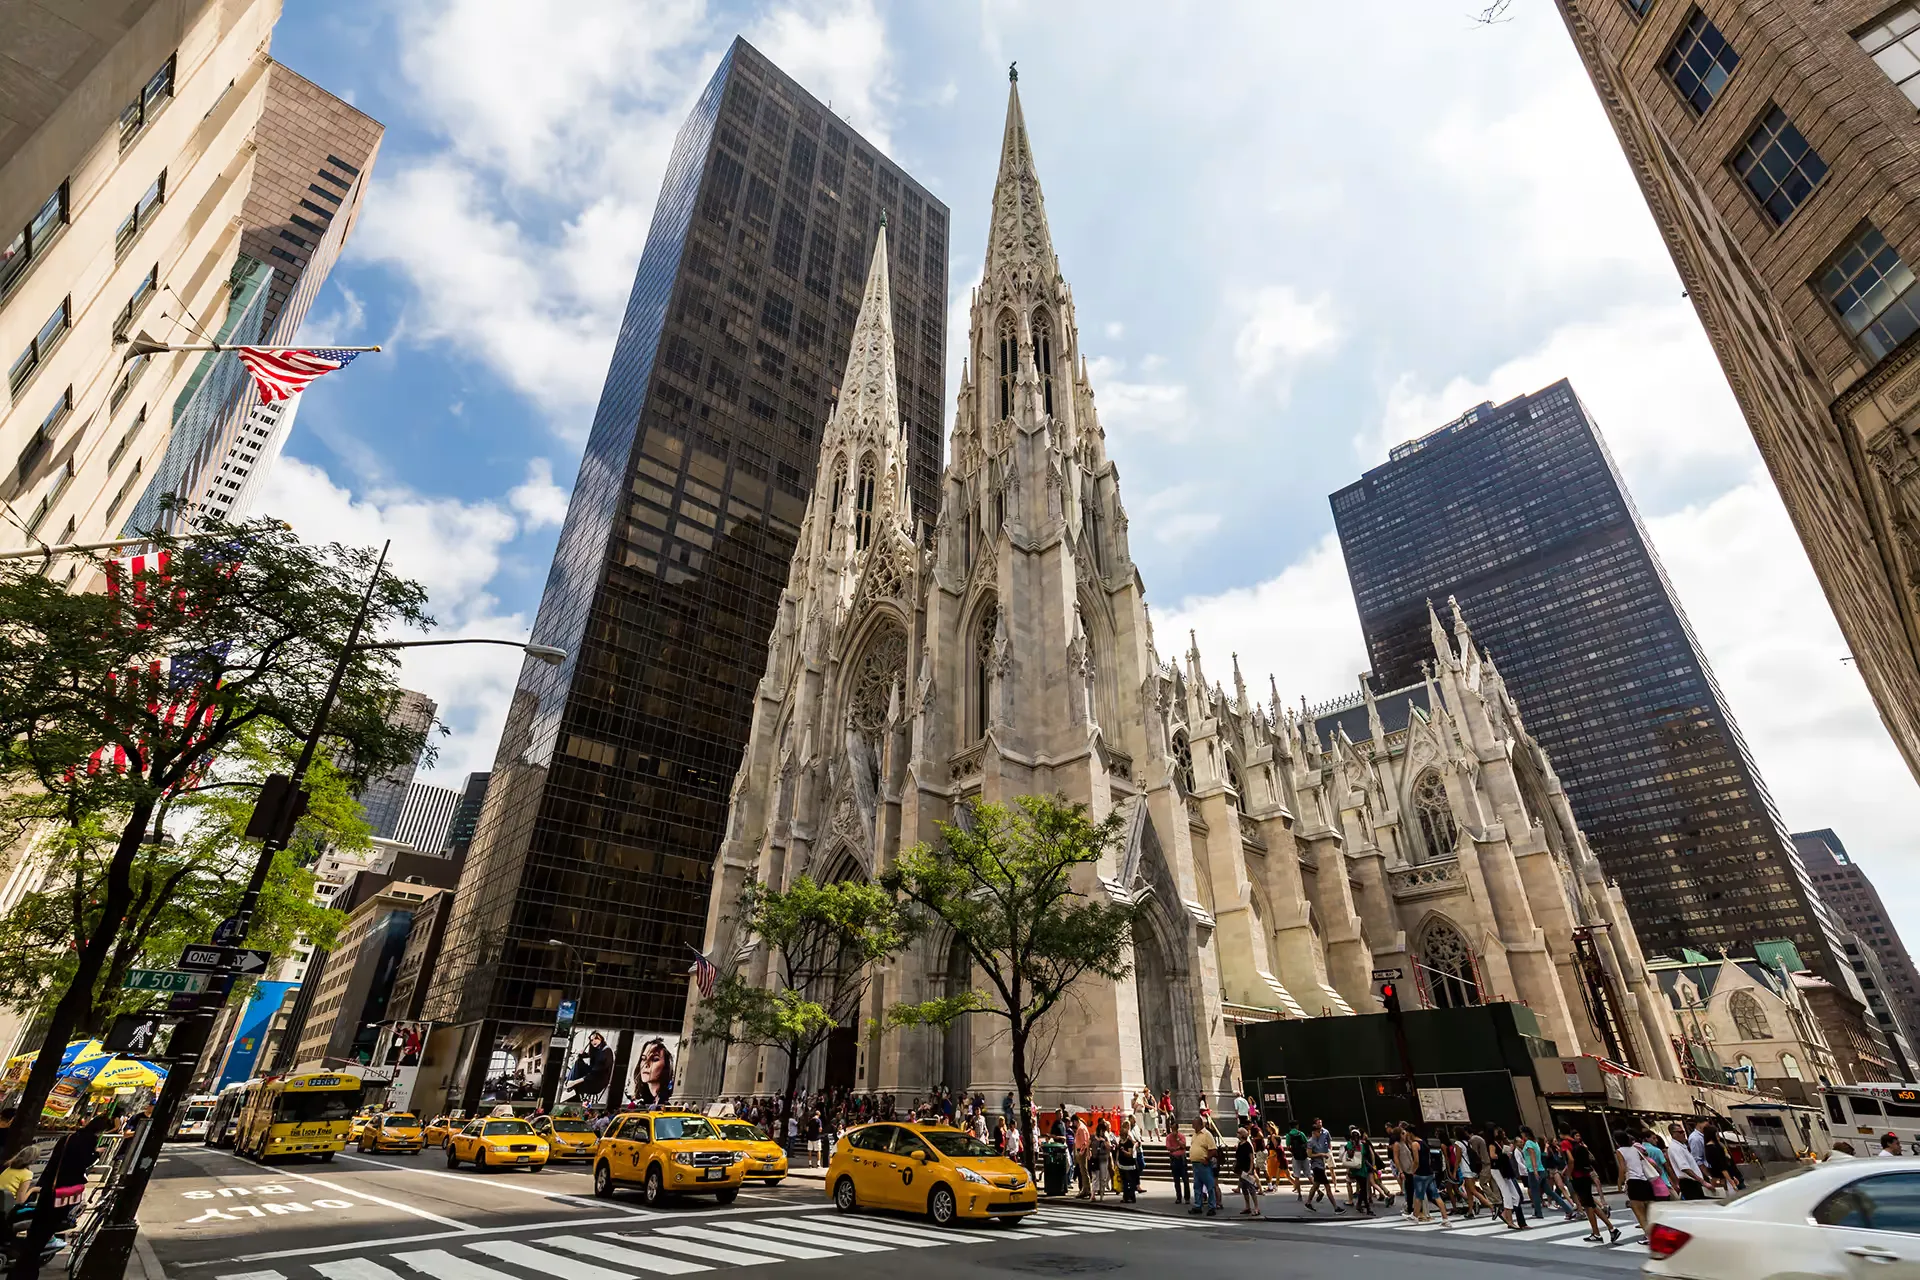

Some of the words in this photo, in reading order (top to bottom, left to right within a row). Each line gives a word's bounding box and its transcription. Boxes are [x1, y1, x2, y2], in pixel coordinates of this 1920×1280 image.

[190, 952, 216, 963] ONE
[130, 972, 145, 986] W
[149, 973, 174, 988] 50
[176, 975, 189, 983] ST
[181, 1184, 295, 1199] BUS
[186, 1199, 354, 1223] ONLY
